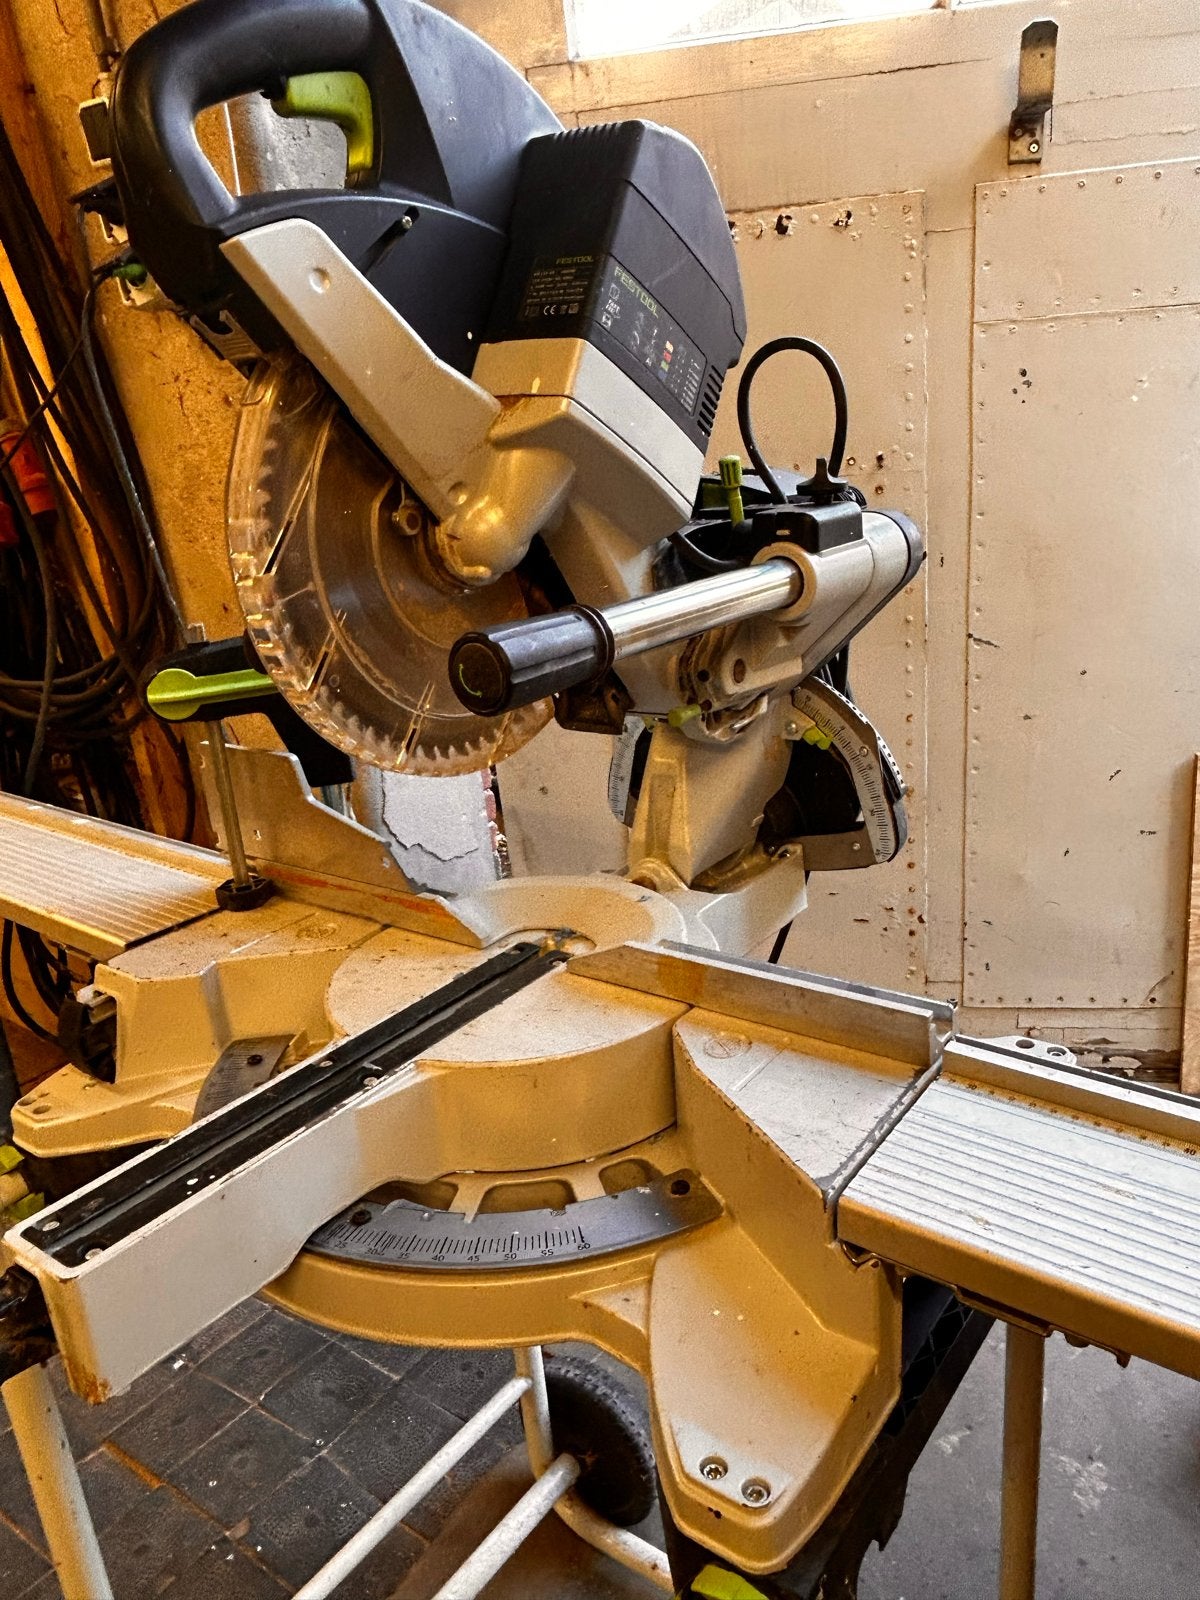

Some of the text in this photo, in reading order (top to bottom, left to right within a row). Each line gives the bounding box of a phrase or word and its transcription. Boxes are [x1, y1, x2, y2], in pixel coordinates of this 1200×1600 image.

[614, 266, 659, 319] FESTOOL
[431, 1254, 445, 1262] 40
[467, 1254, 480, 1262] 45
[504, 1252, 517, 1261] 50
[541, 1248, 554, 1257] 55
[577, 1242, 591, 1251] 60
